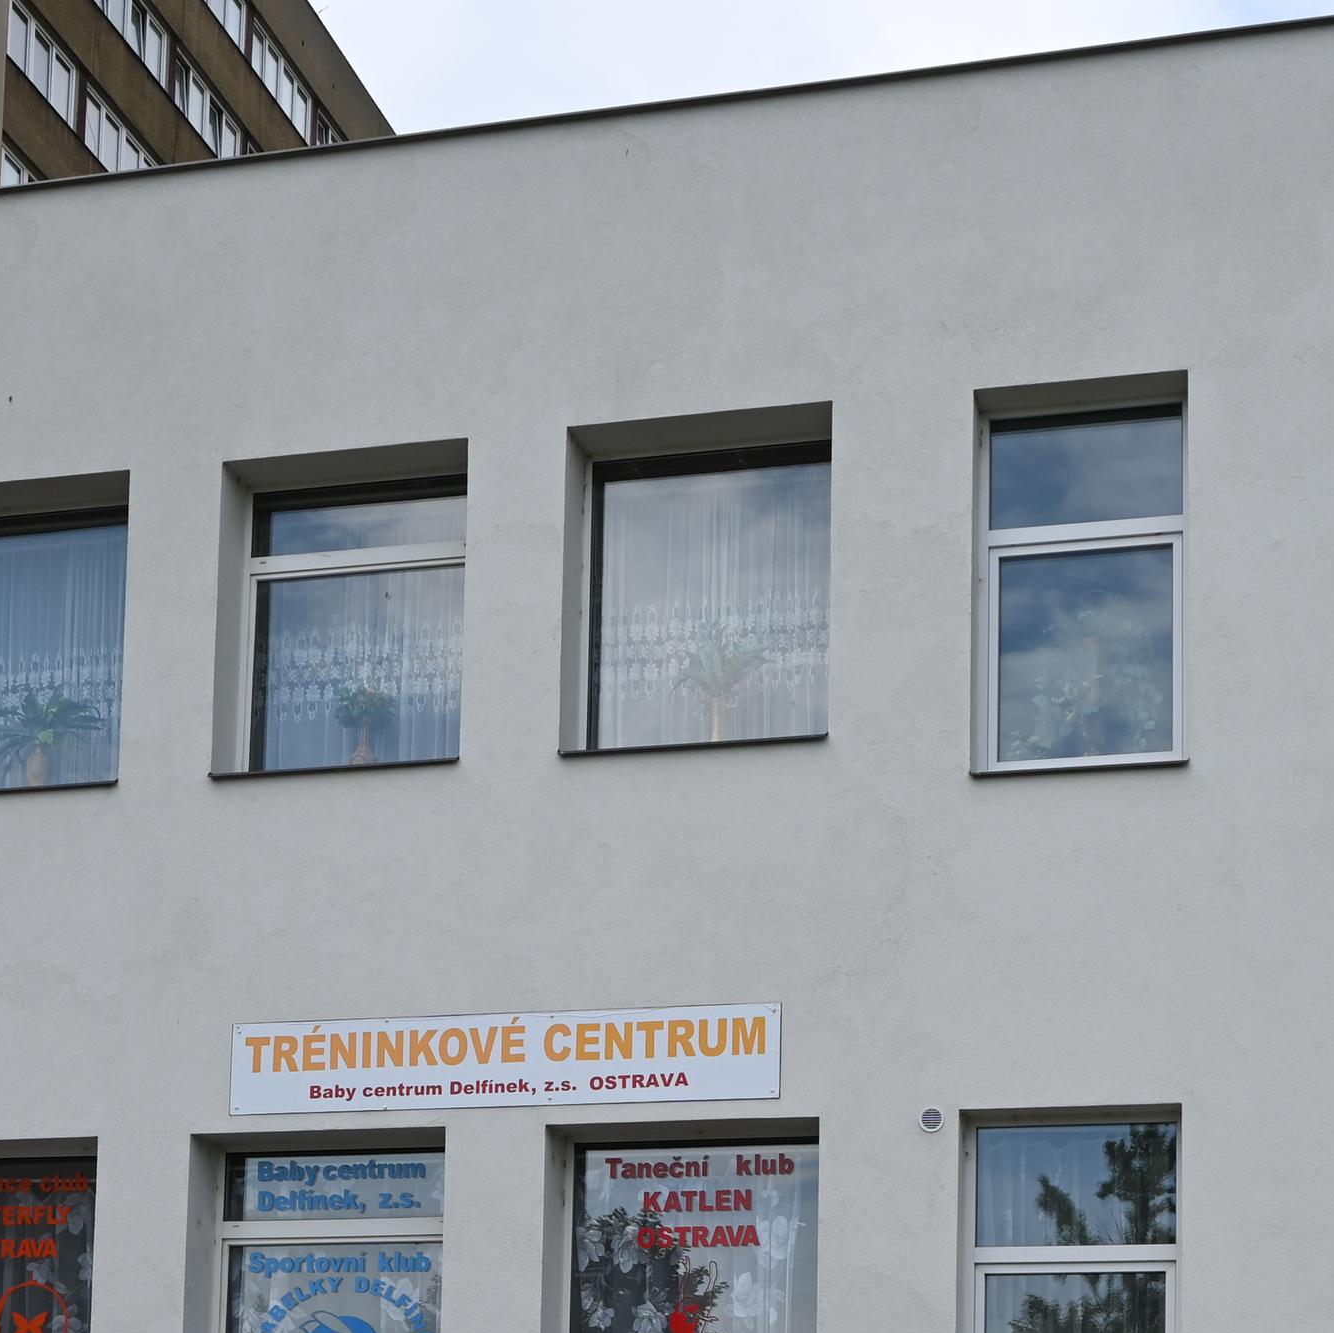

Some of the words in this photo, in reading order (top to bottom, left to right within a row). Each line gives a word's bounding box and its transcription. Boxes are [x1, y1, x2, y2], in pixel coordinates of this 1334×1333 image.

[245, 1017, 526, 1074] TRÉNINKOVÉ
[543, 1016, 766, 1062] CENTRUM
[309, 1083, 356, 1101] Baby
[362, 1082, 442, 1098] centrum
[449, 1077, 536, 1096] Delfínek,
[544, 1076, 578, 1092] z.s.
[588, 1071, 689, 1091] OSTRAVA
[257, 1160, 319, 1186] Baby
[322, 1158, 427, 1181] centrum
[605, 1156, 710, 1179] Taneční
[736, 1153, 795, 1176] klub
[40, 1173, 90, 1192] club
[257, 1189, 366, 1214] Delfínek,
[378, 1193, 422, 1209] z.s.
[643, 1189, 753, 1212] KATLEN
[637, 1225, 761, 1249] OSTRAVA
[249, 1252, 367, 1278] Sportovní
[378, 1251, 432, 1273] klub
